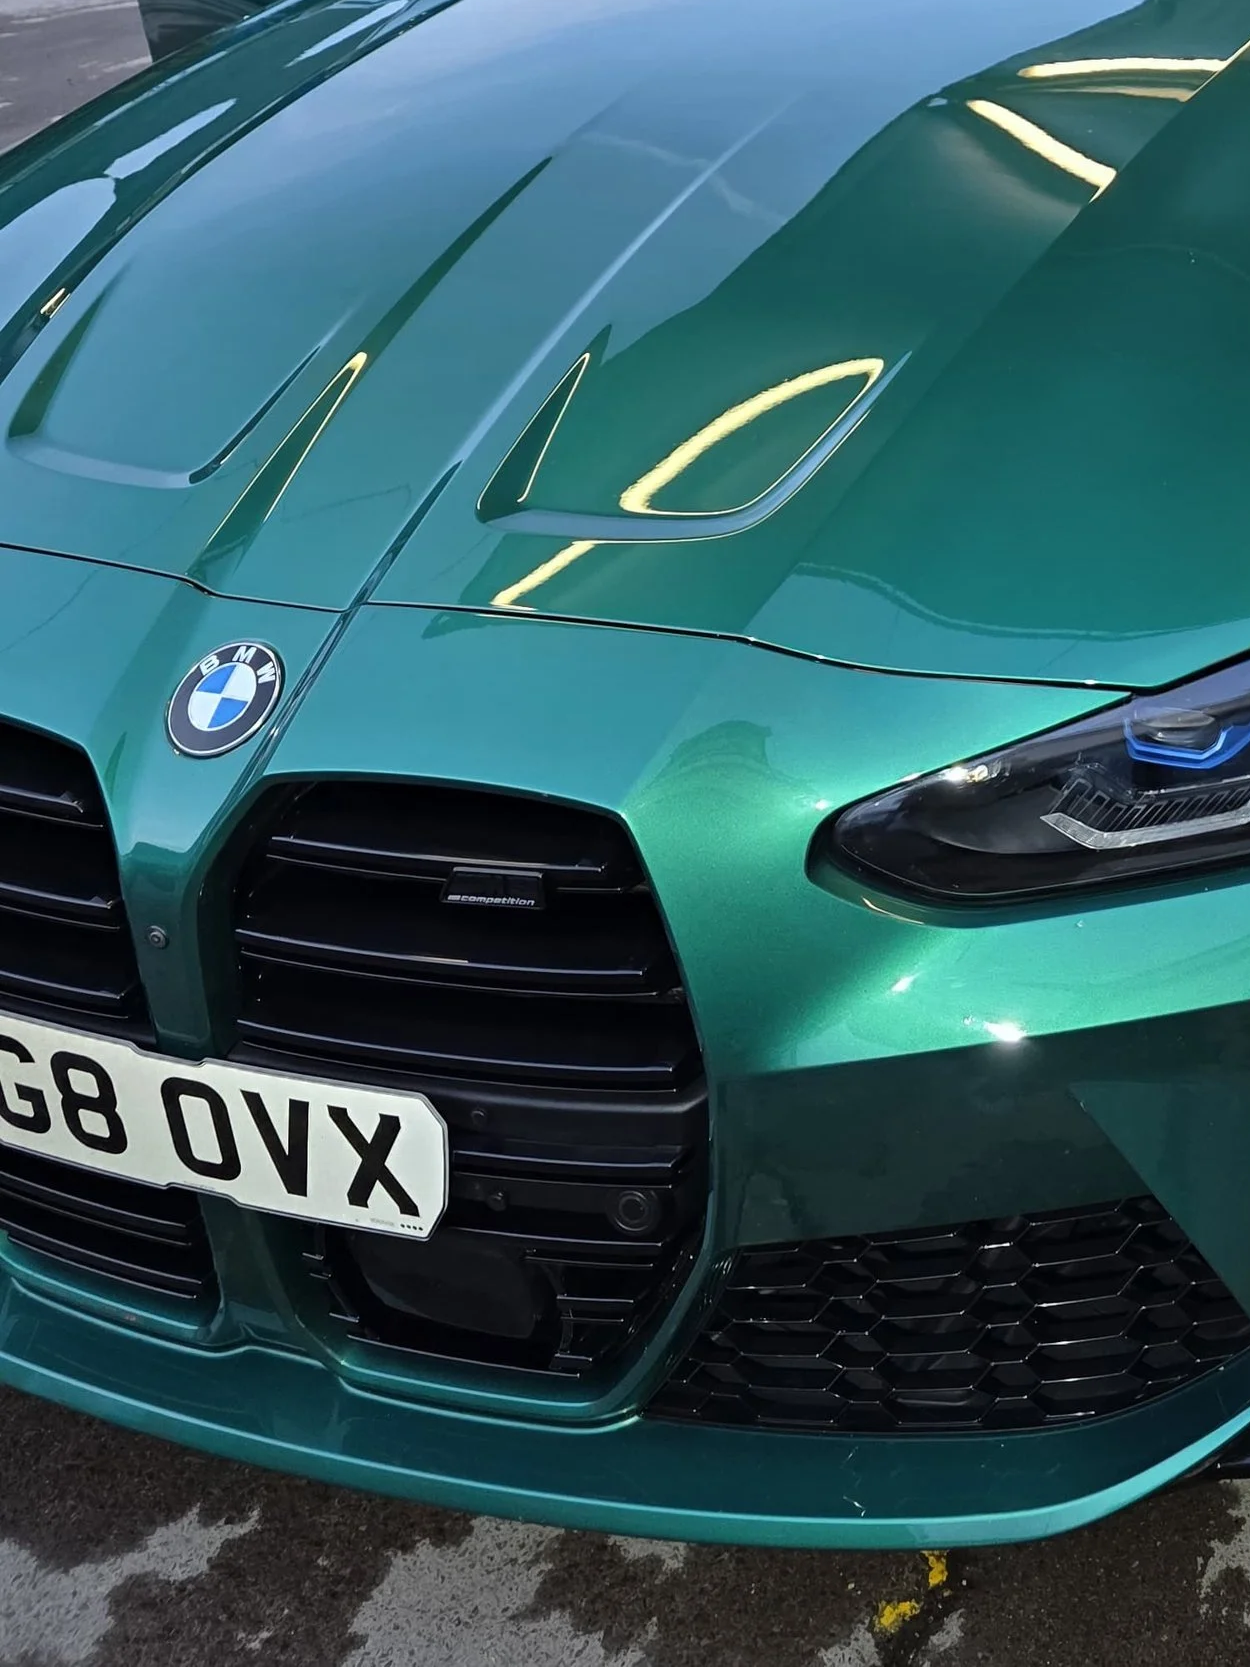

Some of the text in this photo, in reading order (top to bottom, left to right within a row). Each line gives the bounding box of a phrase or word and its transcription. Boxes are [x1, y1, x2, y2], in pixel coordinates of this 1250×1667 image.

[199, 645, 277, 684] BMW
[460, 895, 535, 906] competition
[0, 1036, 421, 1218] G8 OVX
